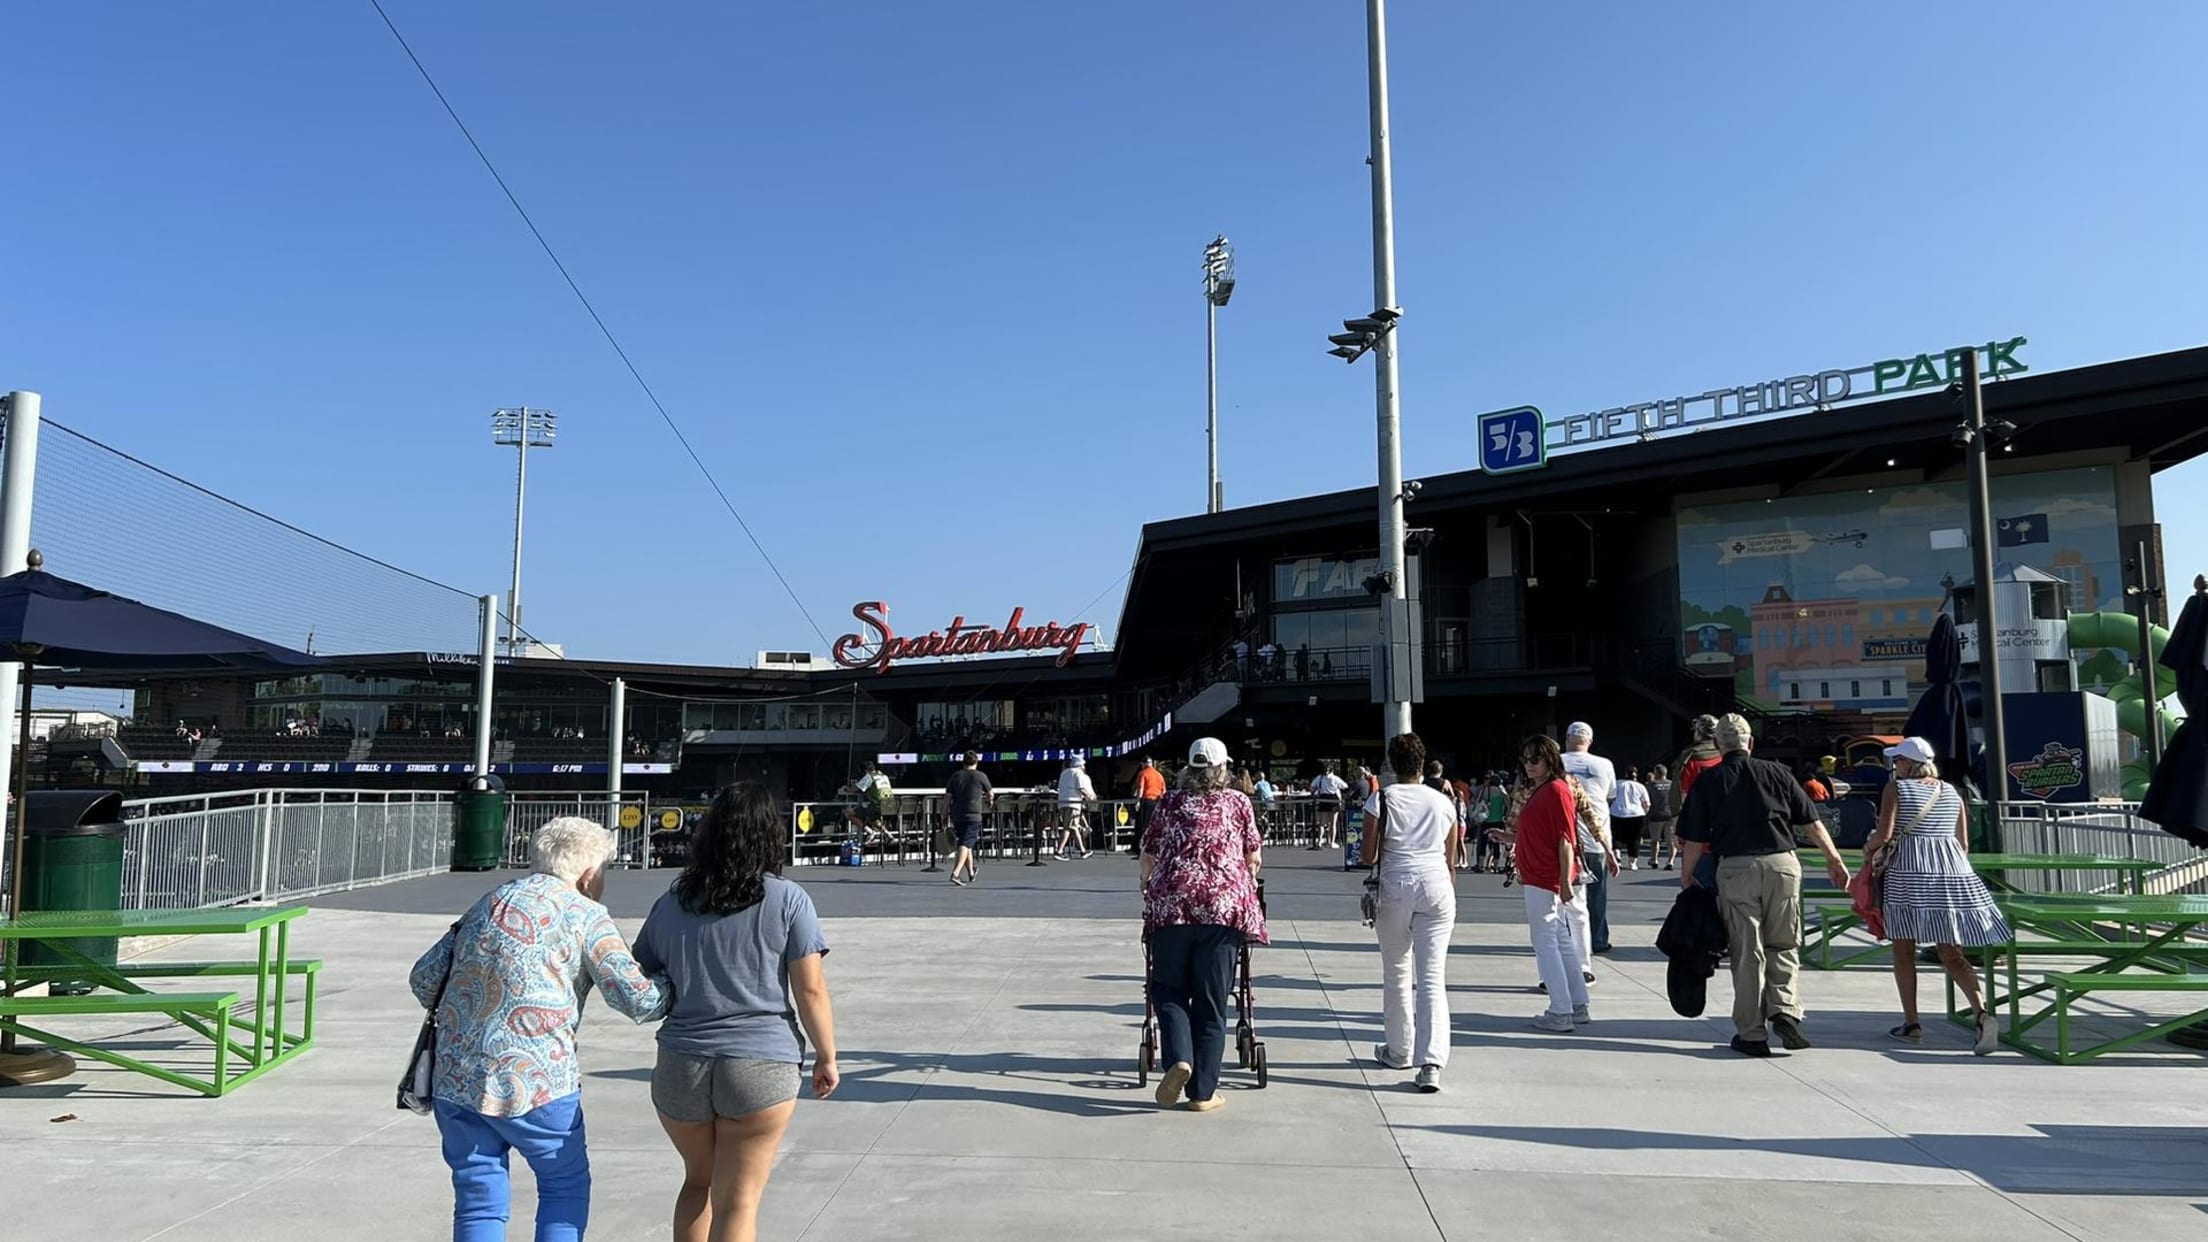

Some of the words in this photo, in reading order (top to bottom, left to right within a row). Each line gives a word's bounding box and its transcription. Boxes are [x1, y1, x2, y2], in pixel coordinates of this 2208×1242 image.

[1564, 396, 1685, 445] FIFTH
[1703, 369, 1851, 420] THIRD
[833, 600, 1089, 674] Spartanburg
[2012, 637, 2050, 648] Center
[1871, 644, 1910, 655] SPARKLE
[1911, 644, 1927, 654] CIT
[552, 764, 569, 773] 6:17
[568, 764, 583, 773] PM
[2021, 766, 2074, 780] SPARTAN
[2025, 773, 2079, 787] BURGERS
